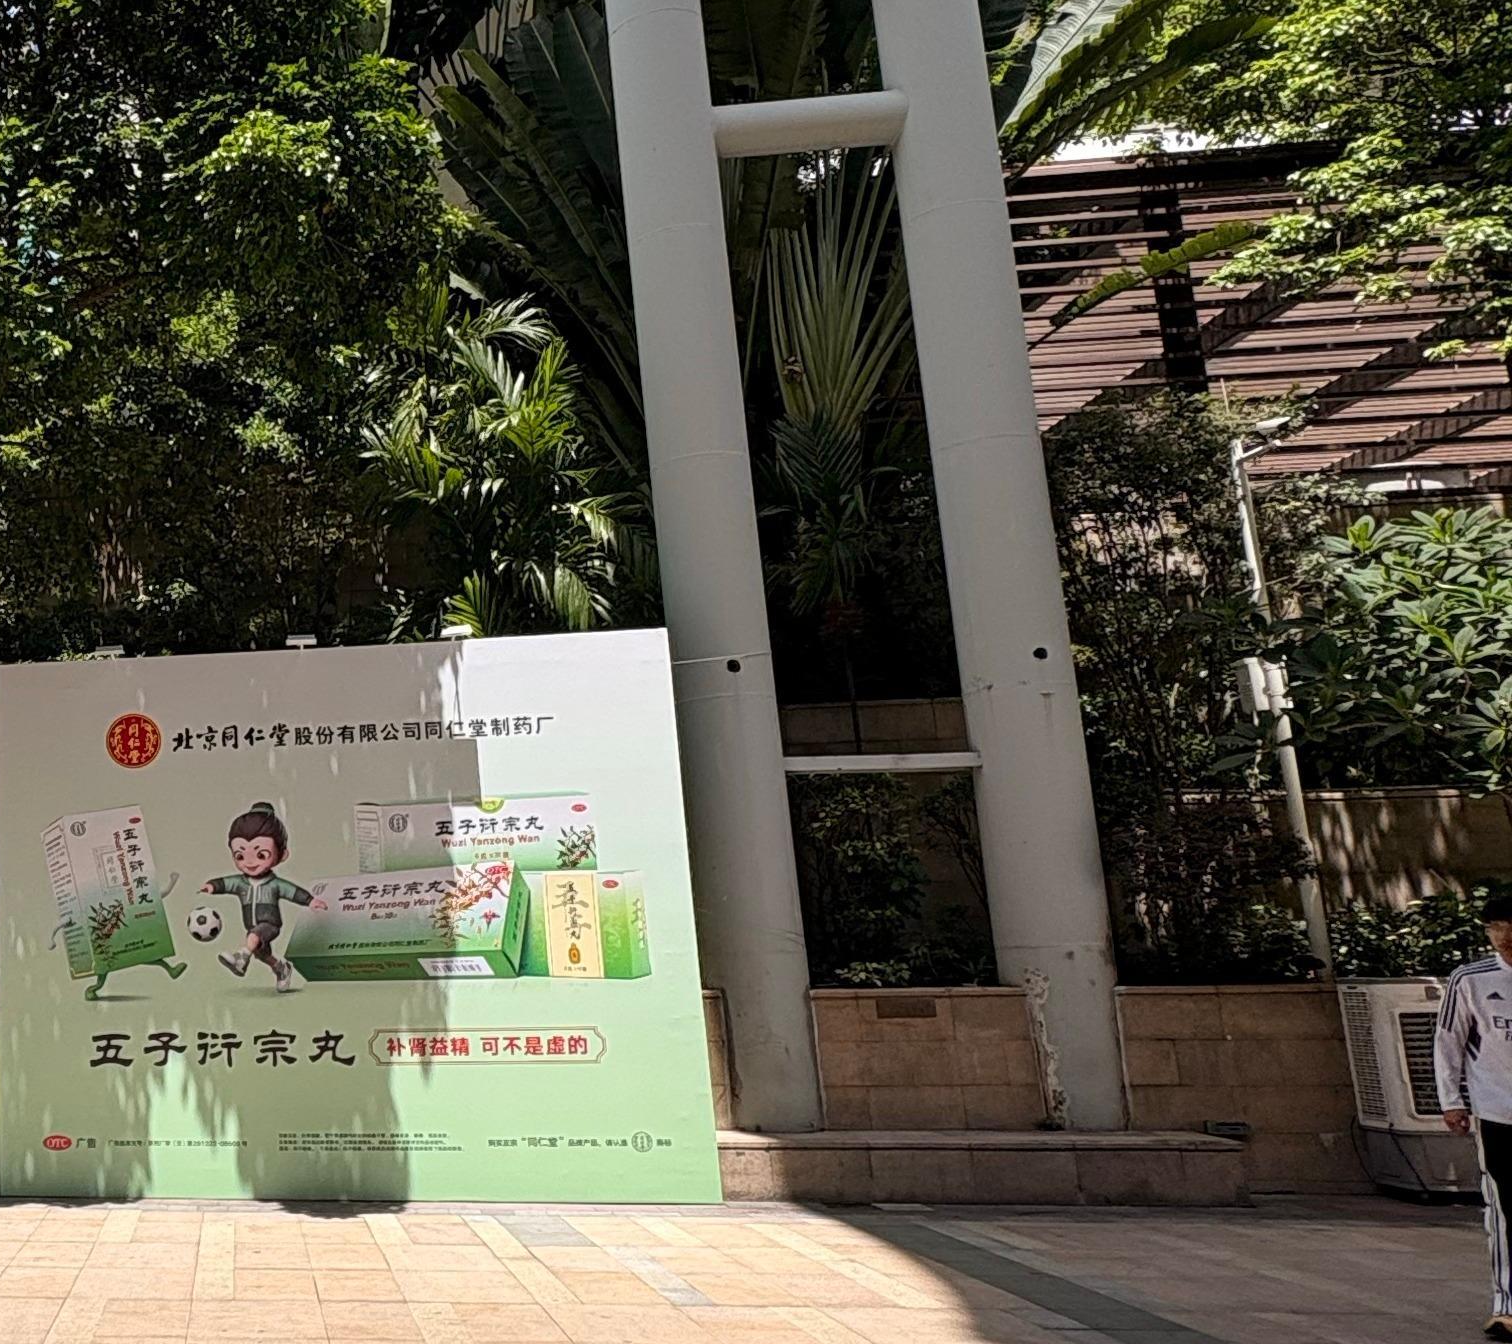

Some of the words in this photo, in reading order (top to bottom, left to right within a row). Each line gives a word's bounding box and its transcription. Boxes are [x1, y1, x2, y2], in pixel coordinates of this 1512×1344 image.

[172, 715, 555, 753] 北京同仁堂股份有限公司同仁堂制药厂
[434, 815, 545, 837] 五子衍宗丸
[441, 837, 467, 848] Wuzi
[469, 834, 516, 847] Yanzong
[516, 834, 541, 844] Wan
[123, 827, 154, 905] 五子衍宗丸
[338, 880, 446, 902] 五子衍宗丸
[89, 1030, 357, 1068] 五子衍宗丸
[386, 1036, 471, 1058] 补肾益精
[482, 1034, 589, 1057] 可不是虚的
[76, 1137, 96, 1149] 广告
